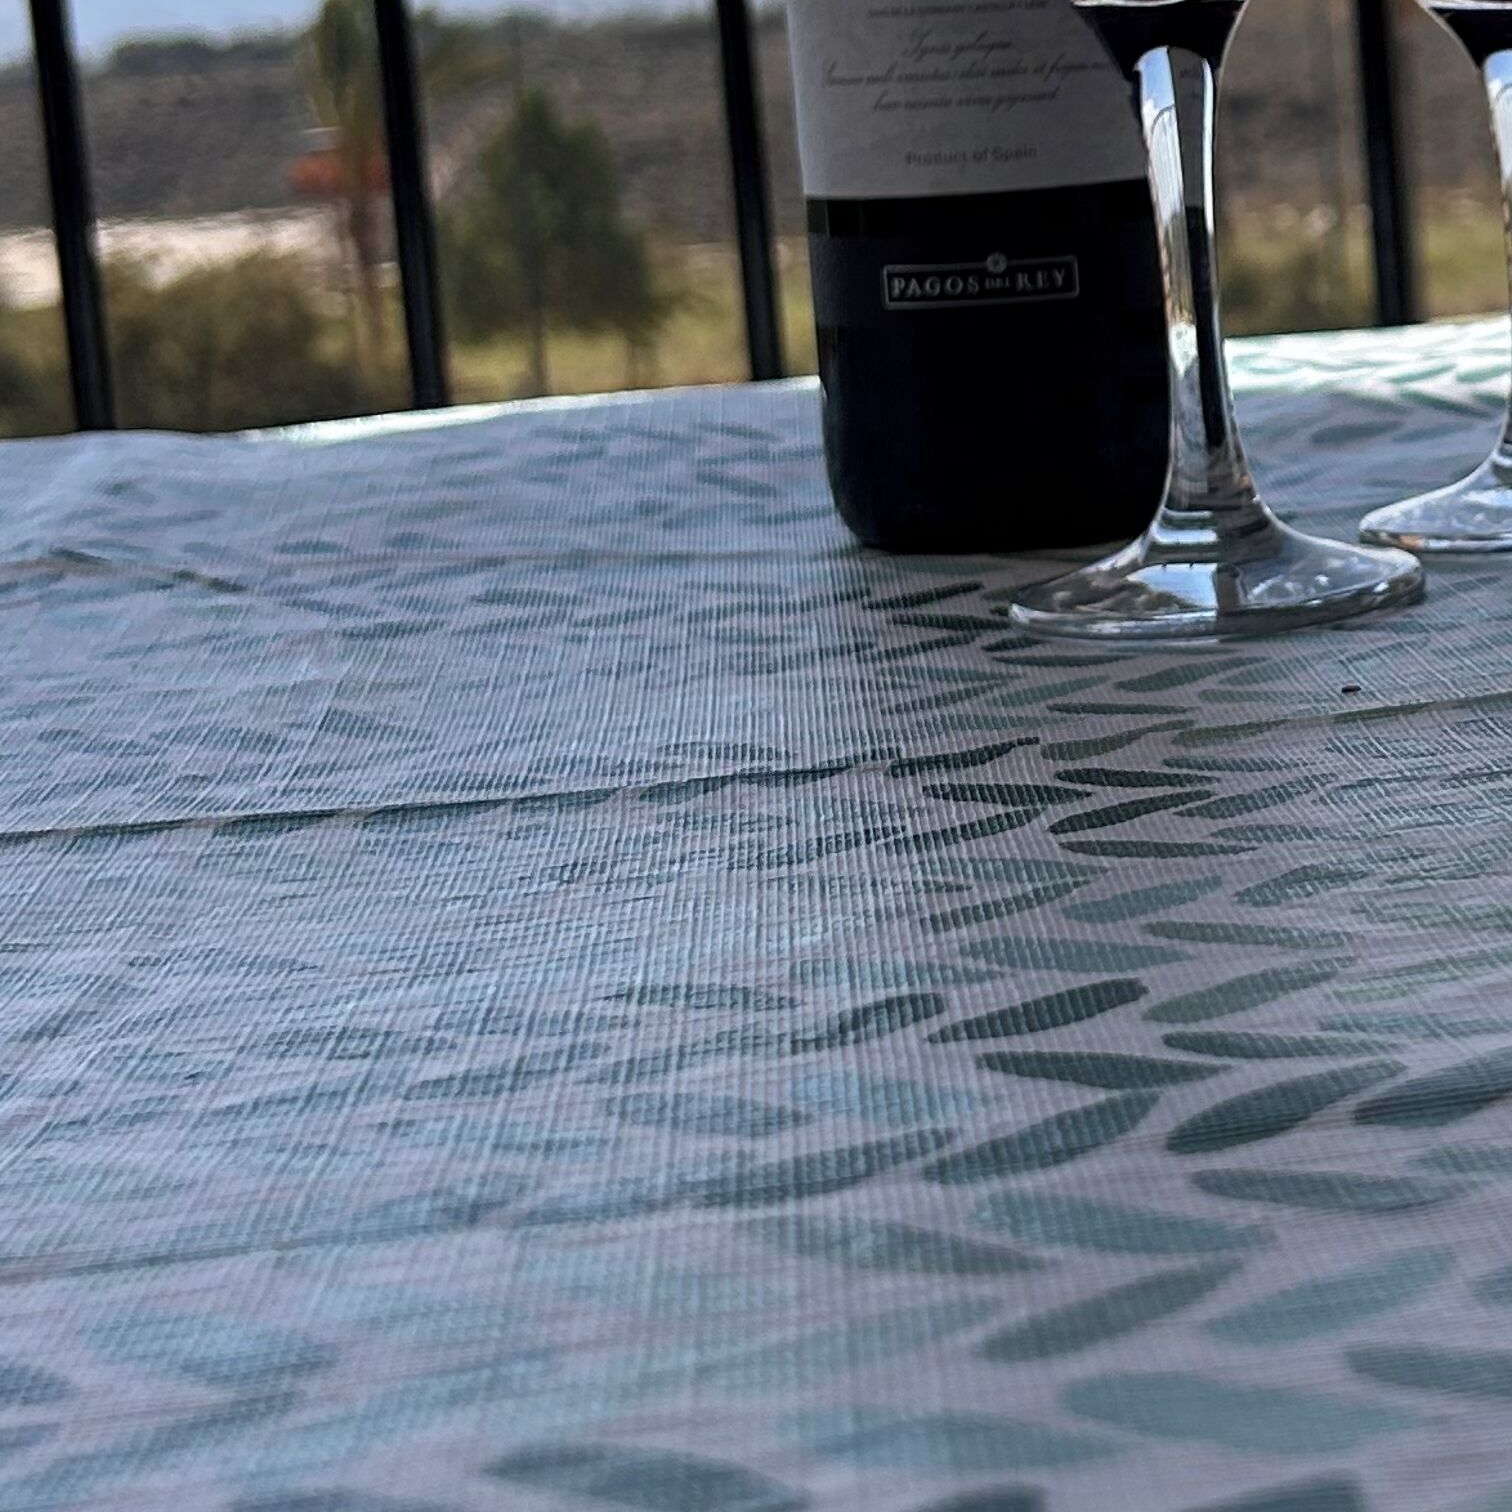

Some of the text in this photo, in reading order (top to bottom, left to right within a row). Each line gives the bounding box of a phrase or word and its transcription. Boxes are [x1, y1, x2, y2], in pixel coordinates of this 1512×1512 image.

[904, 144, 1038, 166] Product of Spain
[890, 275, 980, 299] PAGOS
[1014, 268, 1067, 292] REY
